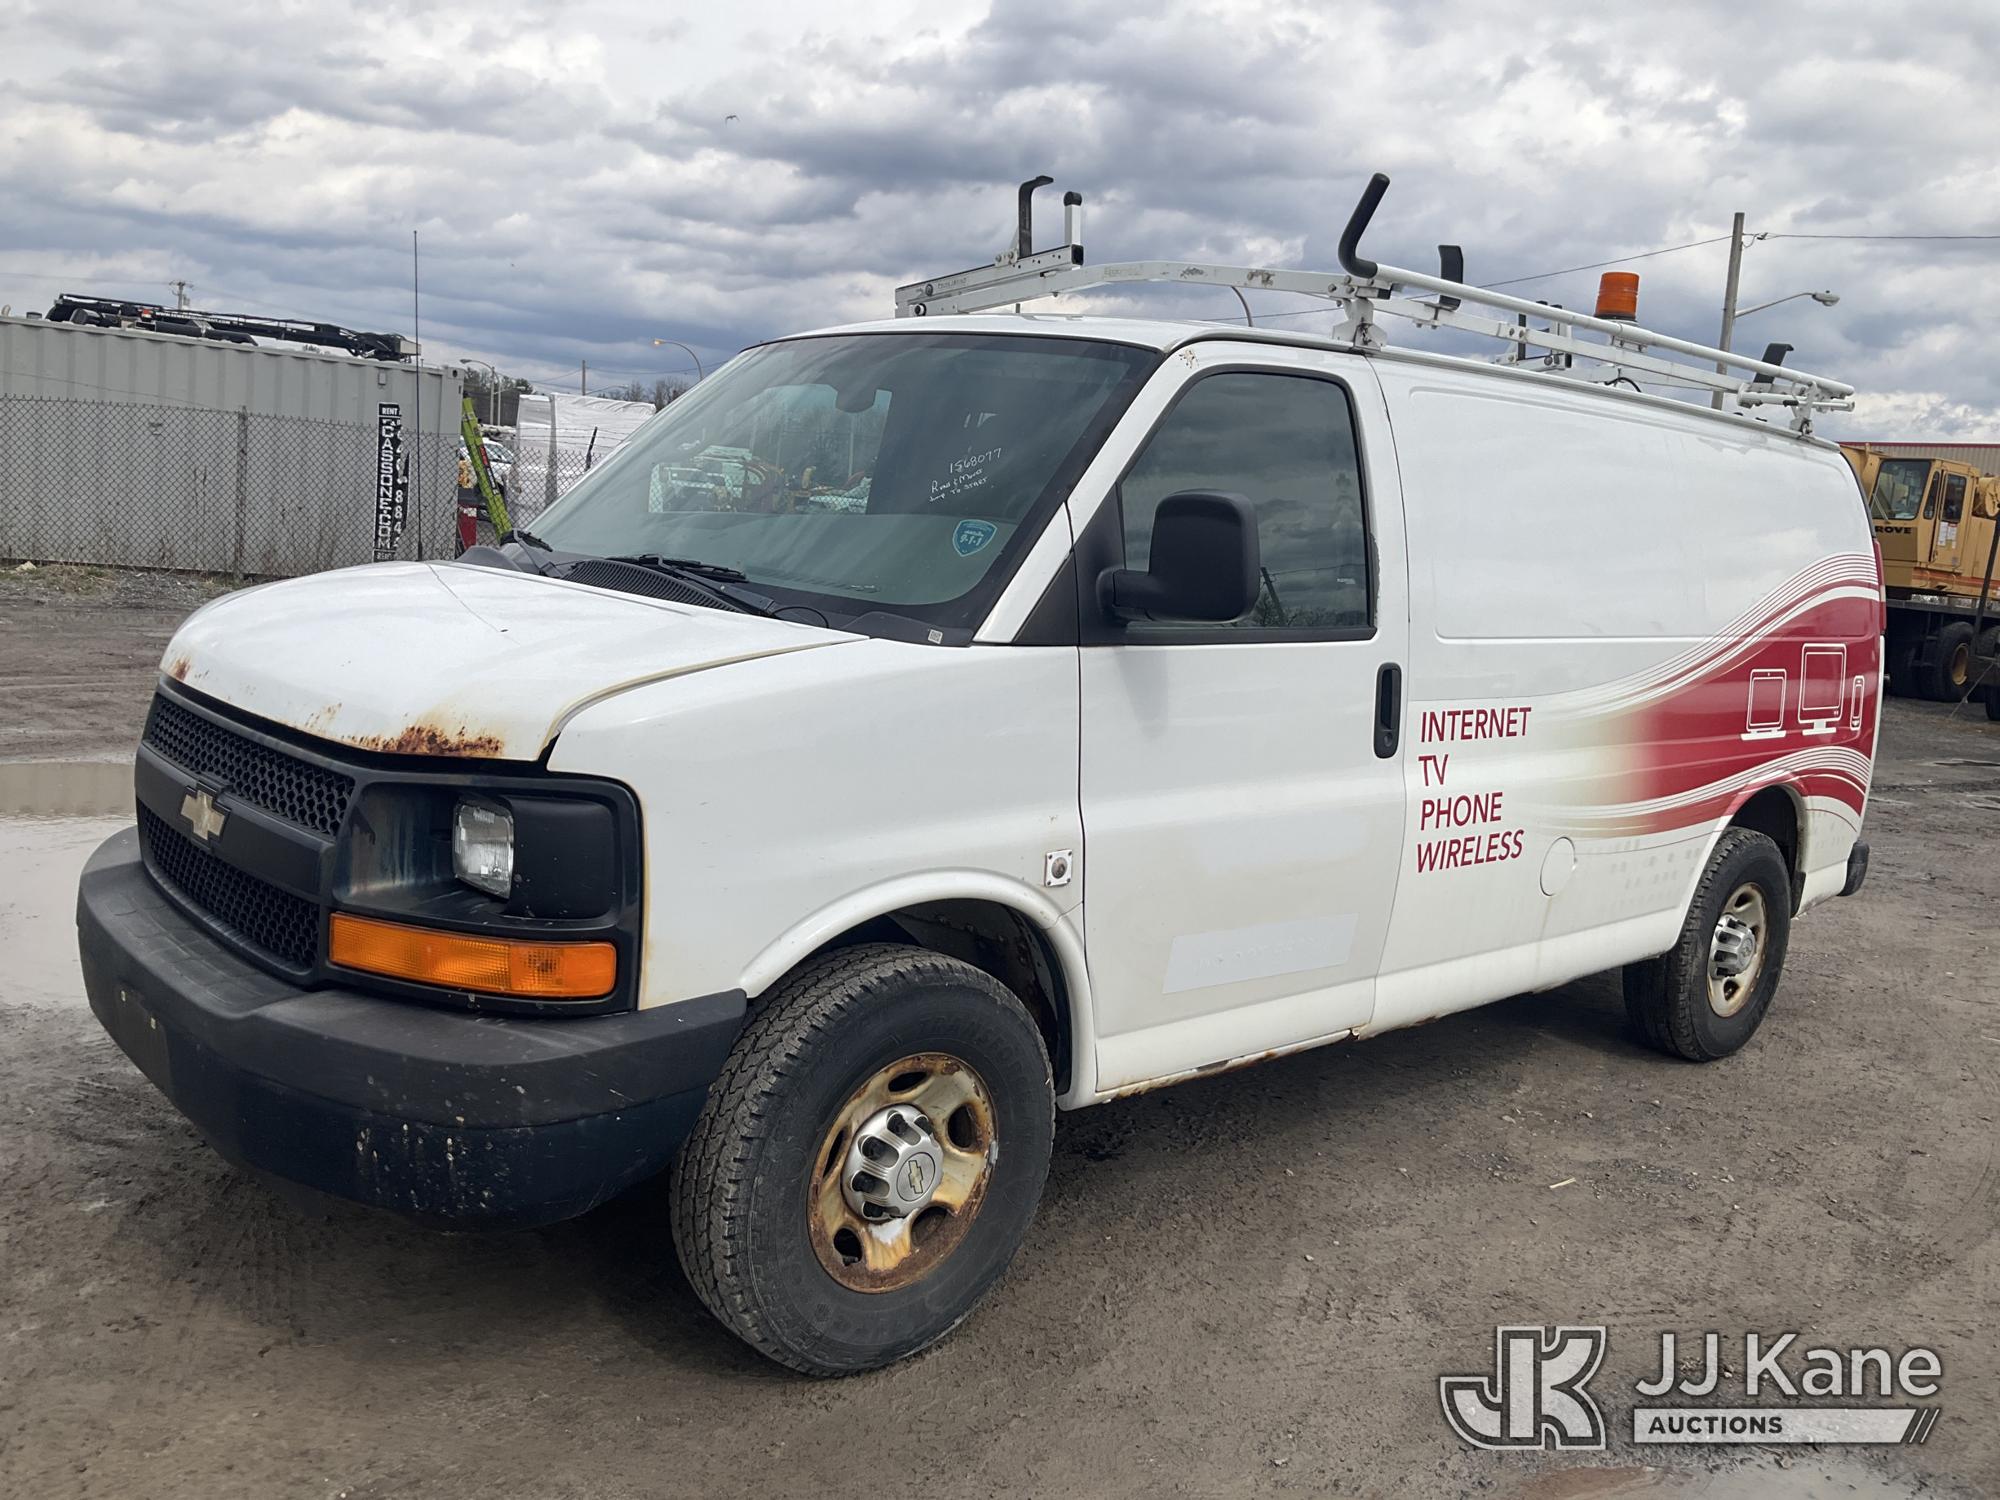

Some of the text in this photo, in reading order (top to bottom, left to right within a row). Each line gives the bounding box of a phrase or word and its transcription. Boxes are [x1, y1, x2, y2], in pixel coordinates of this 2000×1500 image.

[382, 407, 398, 415] RENT
[1875, 526, 1912, 534] ROVE
[1421, 707, 1532, 742] INTERNET
[1418, 754, 1449, 786] TV
[1421, 792, 1503, 831] PHONE
[1417, 829, 1525, 873] WIRELESS
